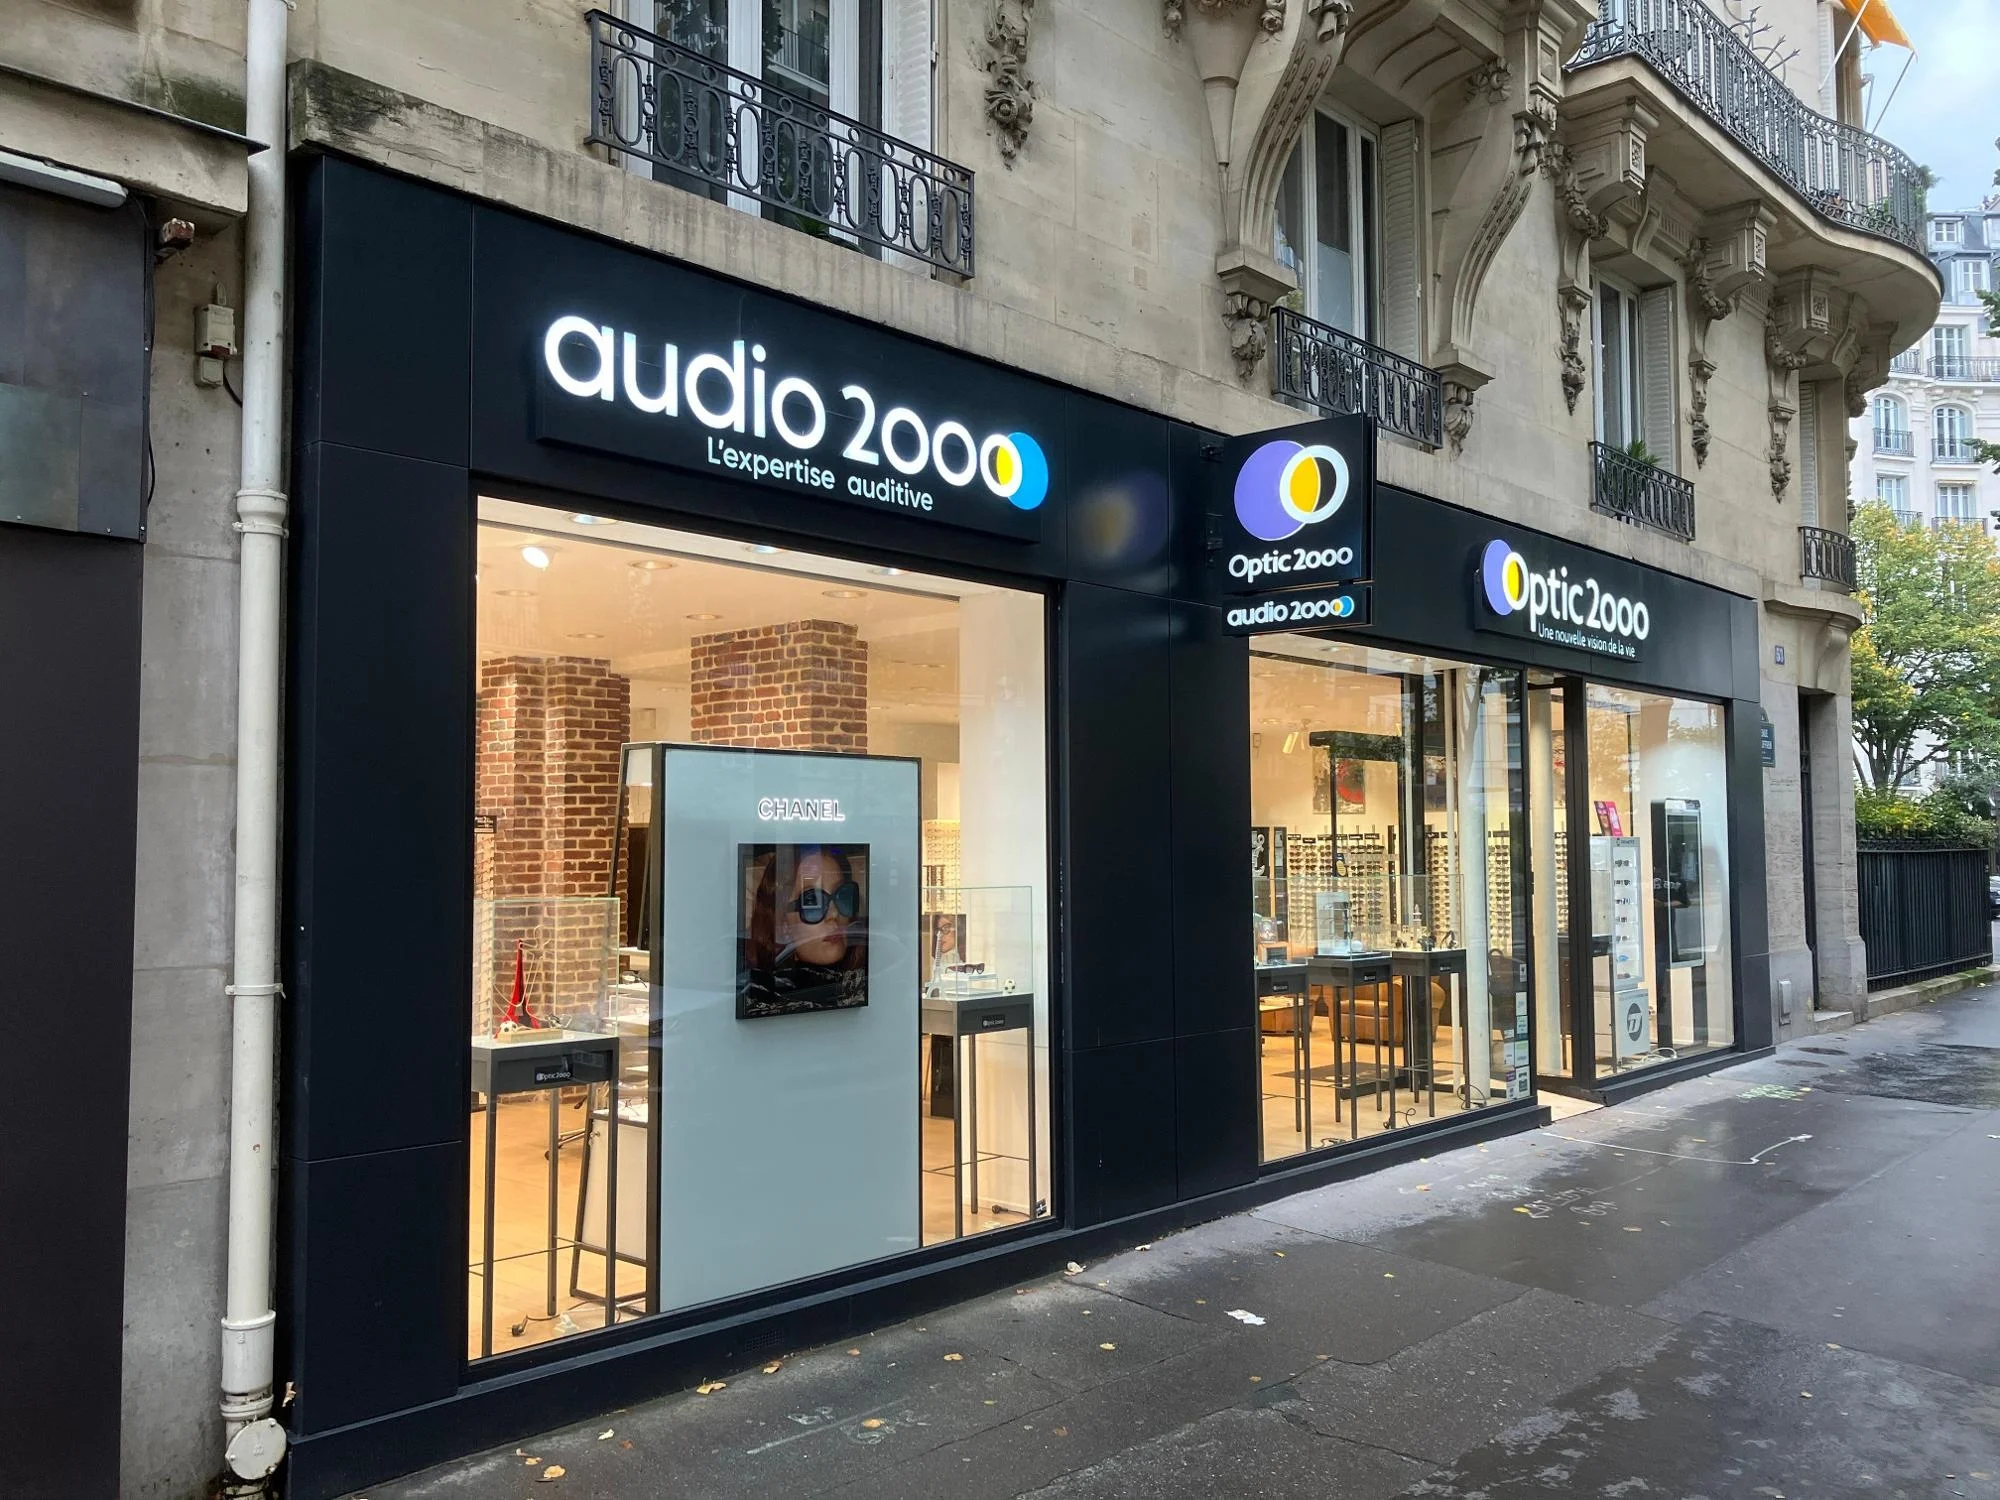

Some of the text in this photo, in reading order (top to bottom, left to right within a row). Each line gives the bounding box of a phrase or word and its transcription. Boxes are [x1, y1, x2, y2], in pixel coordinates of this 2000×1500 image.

[544, 315, 1024, 498] audio 2000
[707, 436, 934, 511] L'expertise auditive
[1227, 598, 1344, 627] audio 2000
[1538, 622, 1636, 658] Une nouvelle vision de la vie
[758, 797, 846, 822] CHANEL
